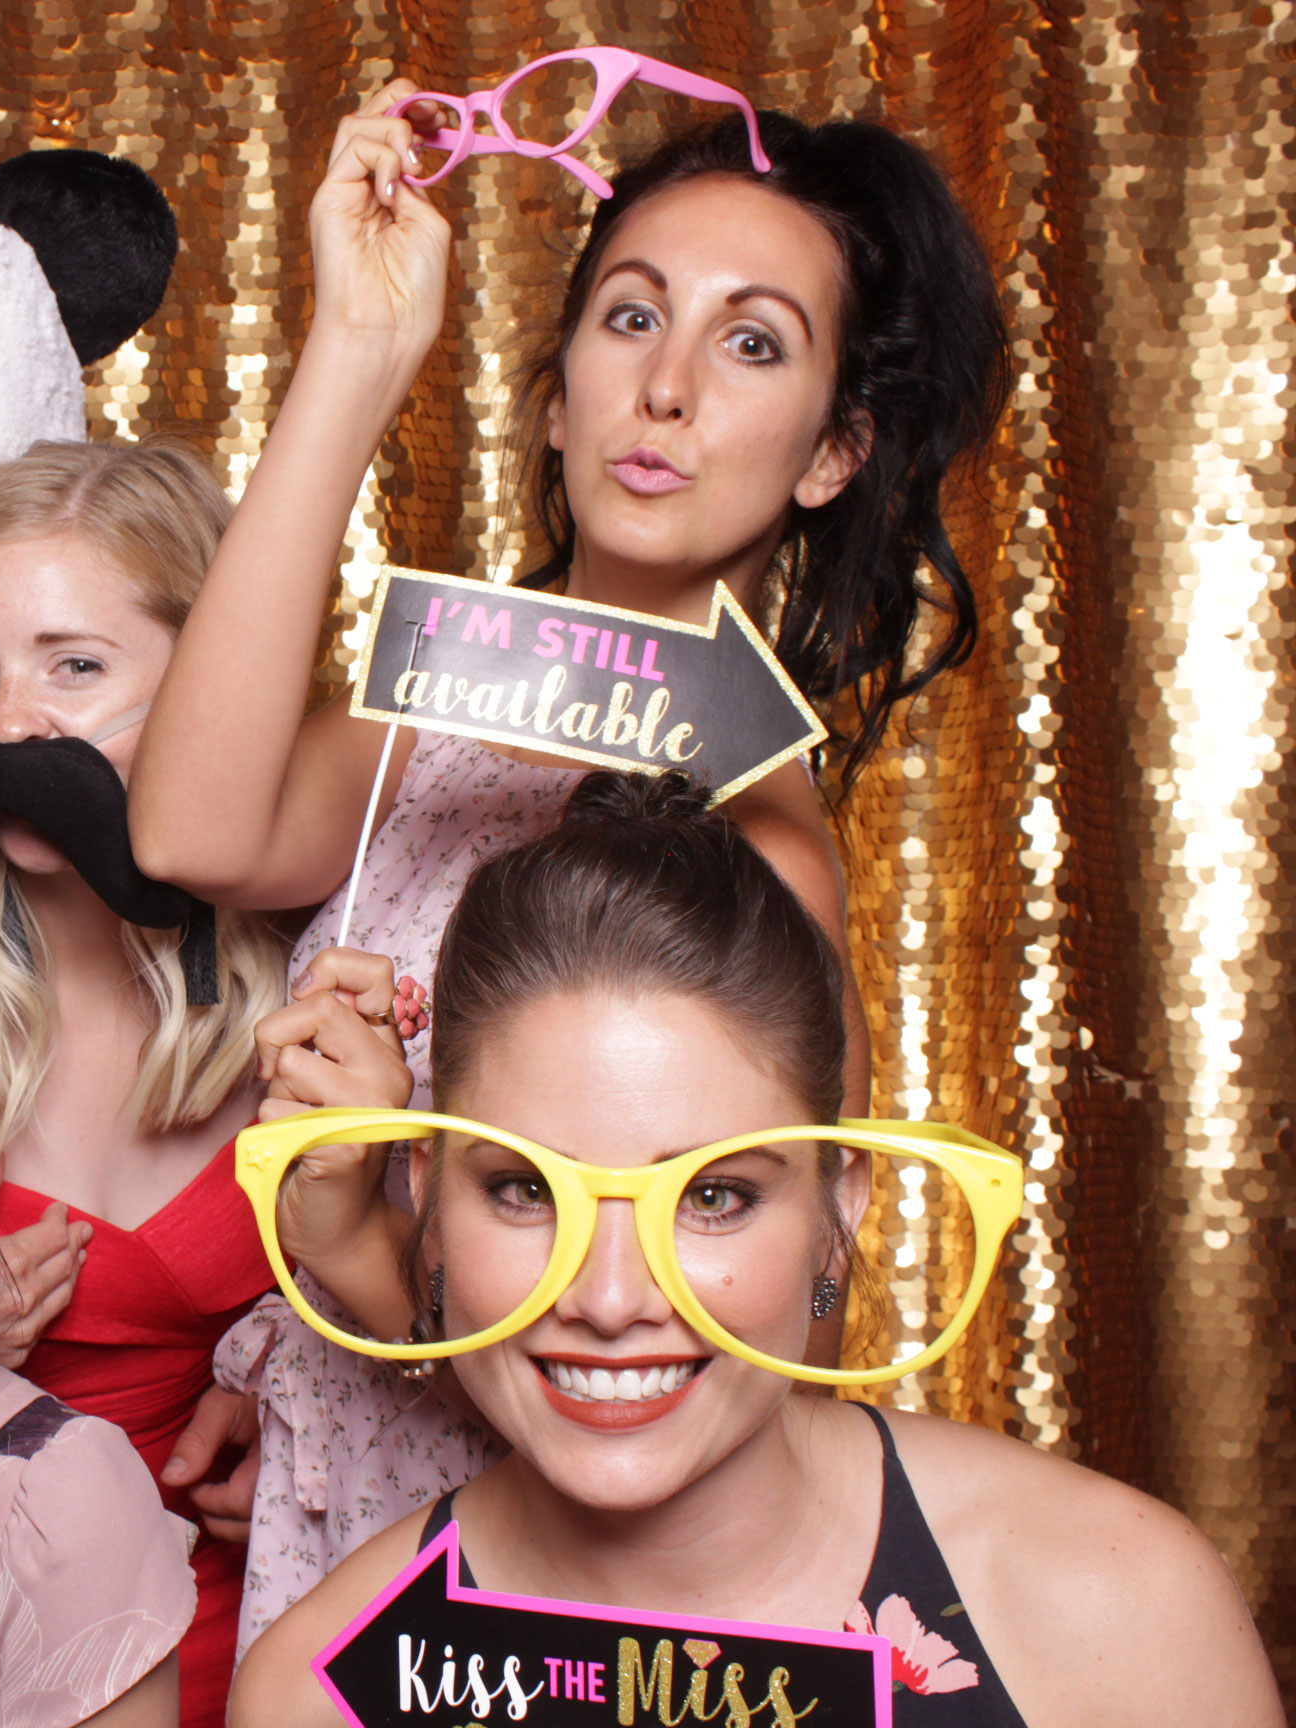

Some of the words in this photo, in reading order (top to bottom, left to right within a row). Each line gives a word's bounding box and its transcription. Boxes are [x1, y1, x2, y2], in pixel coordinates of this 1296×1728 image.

[424, 597, 512, 650] I'M
[533, 617, 666, 683] STILL
[393, 664, 703, 763] available
[398, 1633, 545, 1720] Kiss
[543, 1656, 606, 1703] THE
[617, 1636, 819, 1728] Miss
